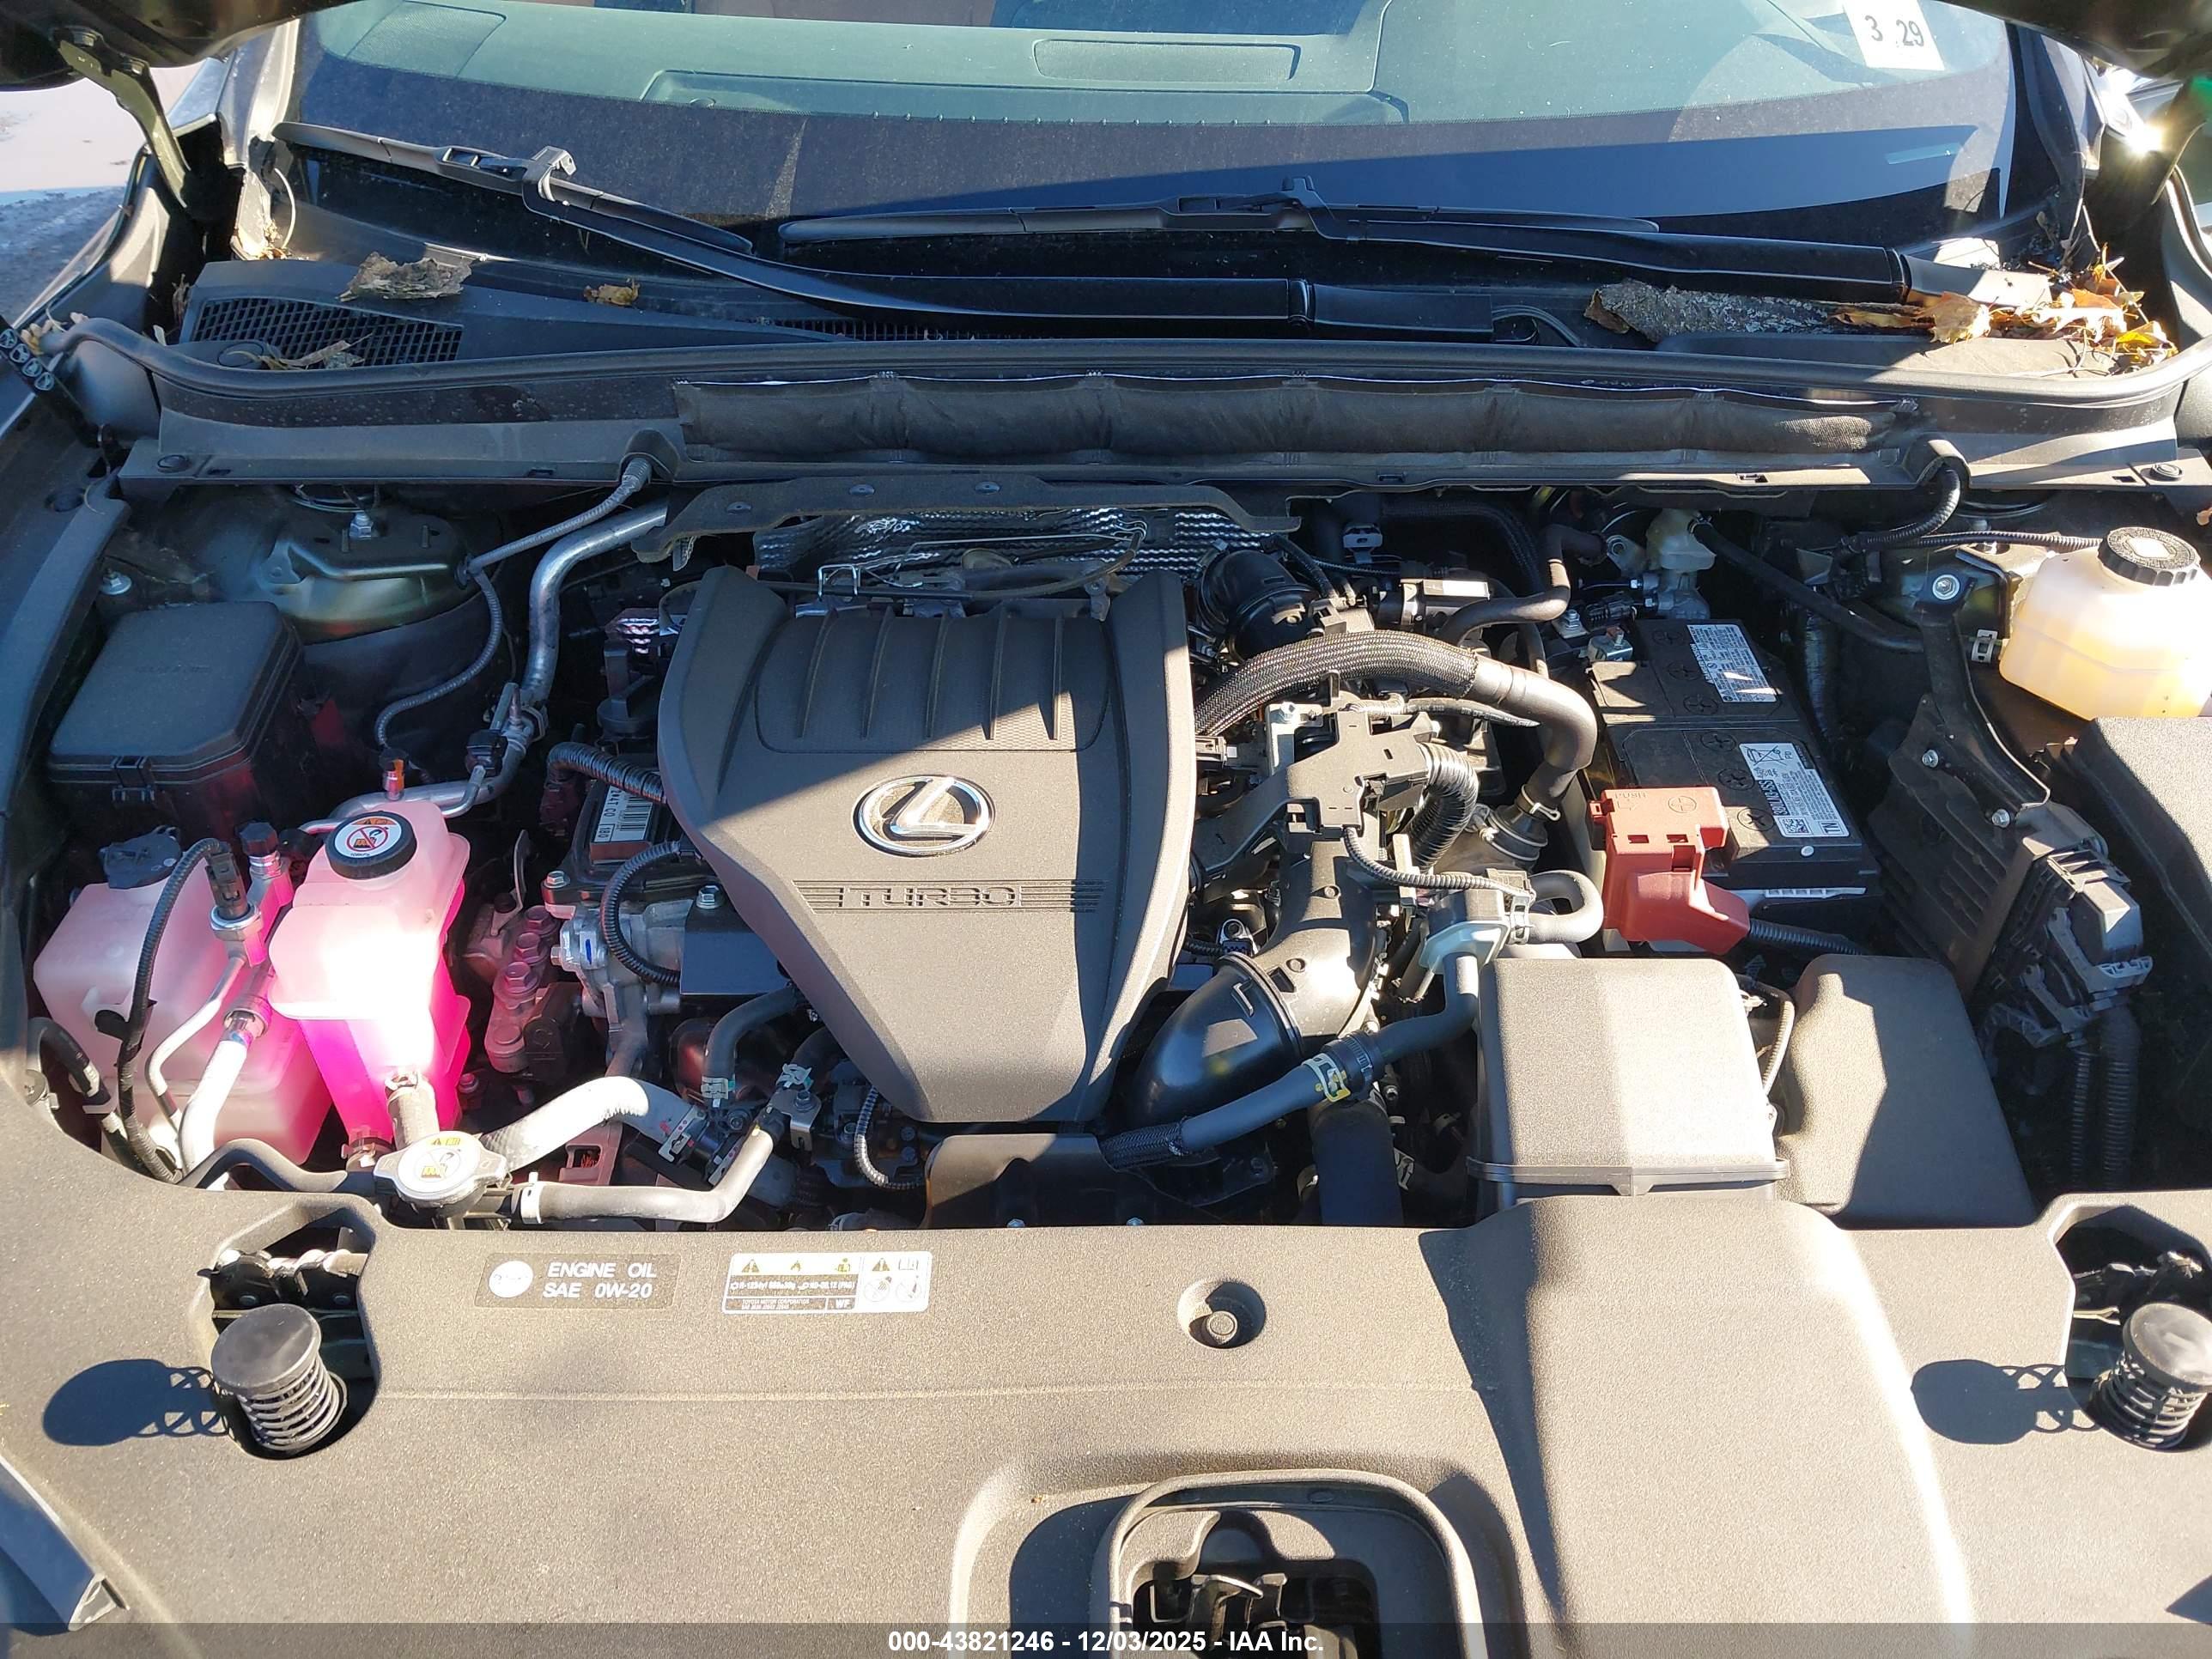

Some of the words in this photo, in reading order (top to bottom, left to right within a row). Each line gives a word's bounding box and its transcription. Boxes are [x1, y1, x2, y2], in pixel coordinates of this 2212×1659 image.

[1864, 15, 1884, 42] 3
[1895, 19, 1924, 46] 29
[847, 886, 1016, 907] TURBO
[547, 1261, 617, 1279] ENGINE
[628, 1261, 657, 1279] OIL
[543, 1283, 581, 1298] SAE
[594, 1283, 653, 1298] 0W-20
